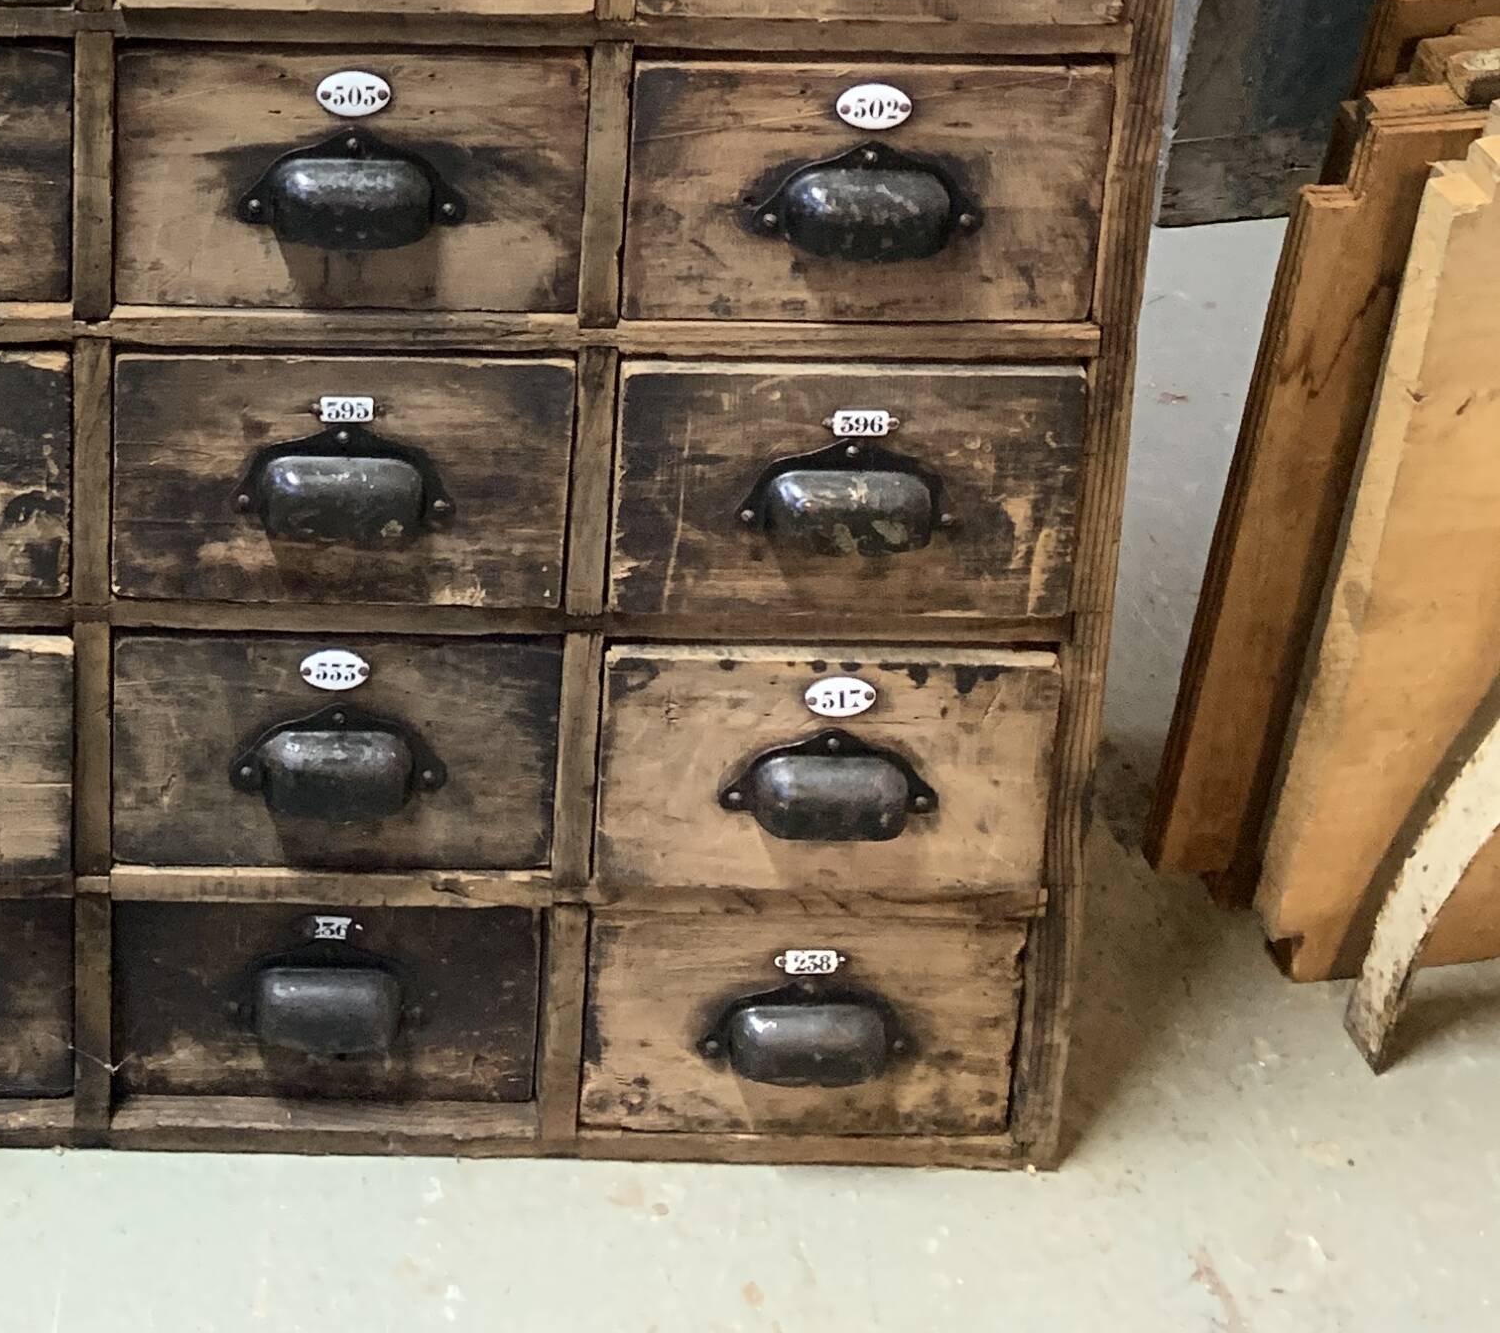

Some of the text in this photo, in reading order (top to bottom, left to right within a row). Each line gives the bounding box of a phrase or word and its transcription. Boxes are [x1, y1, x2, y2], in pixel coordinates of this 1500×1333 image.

[854, 98, 898, 119] 502
[840, 416, 883, 433] 396
[821, 689, 861, 709] 517
[795, 954, 831, 972] 238
